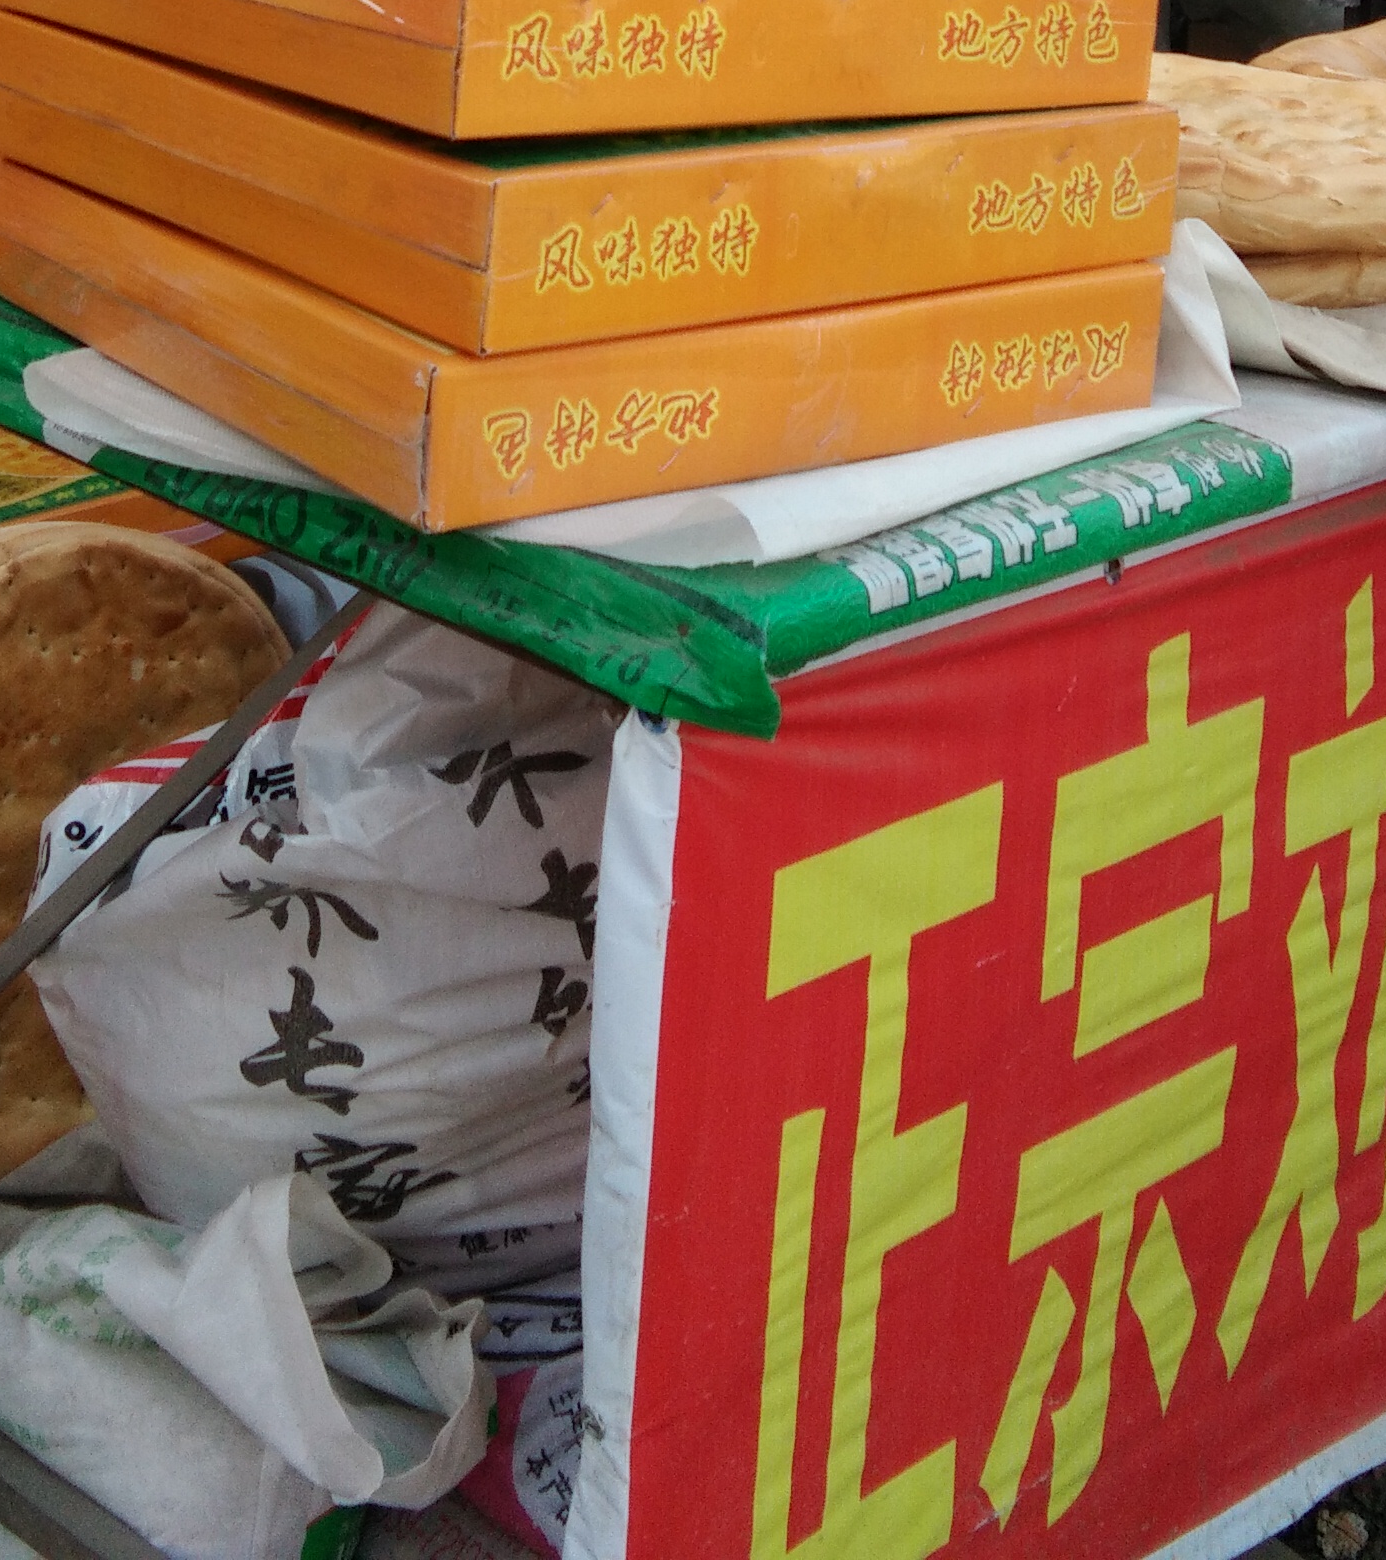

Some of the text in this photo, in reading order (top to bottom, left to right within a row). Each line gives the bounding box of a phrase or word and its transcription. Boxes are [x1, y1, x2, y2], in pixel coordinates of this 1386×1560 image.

[502, 5, 725, 81] 风味独特
[938, 0, 1119, 67] 地方特色
[969, 156, 1144, 234] 地方特色
[537, 204, 759, 294] 风味独特
[940, 323, 1129, 406] 风味独特
[484, 386, 720, 478] 地方特色
